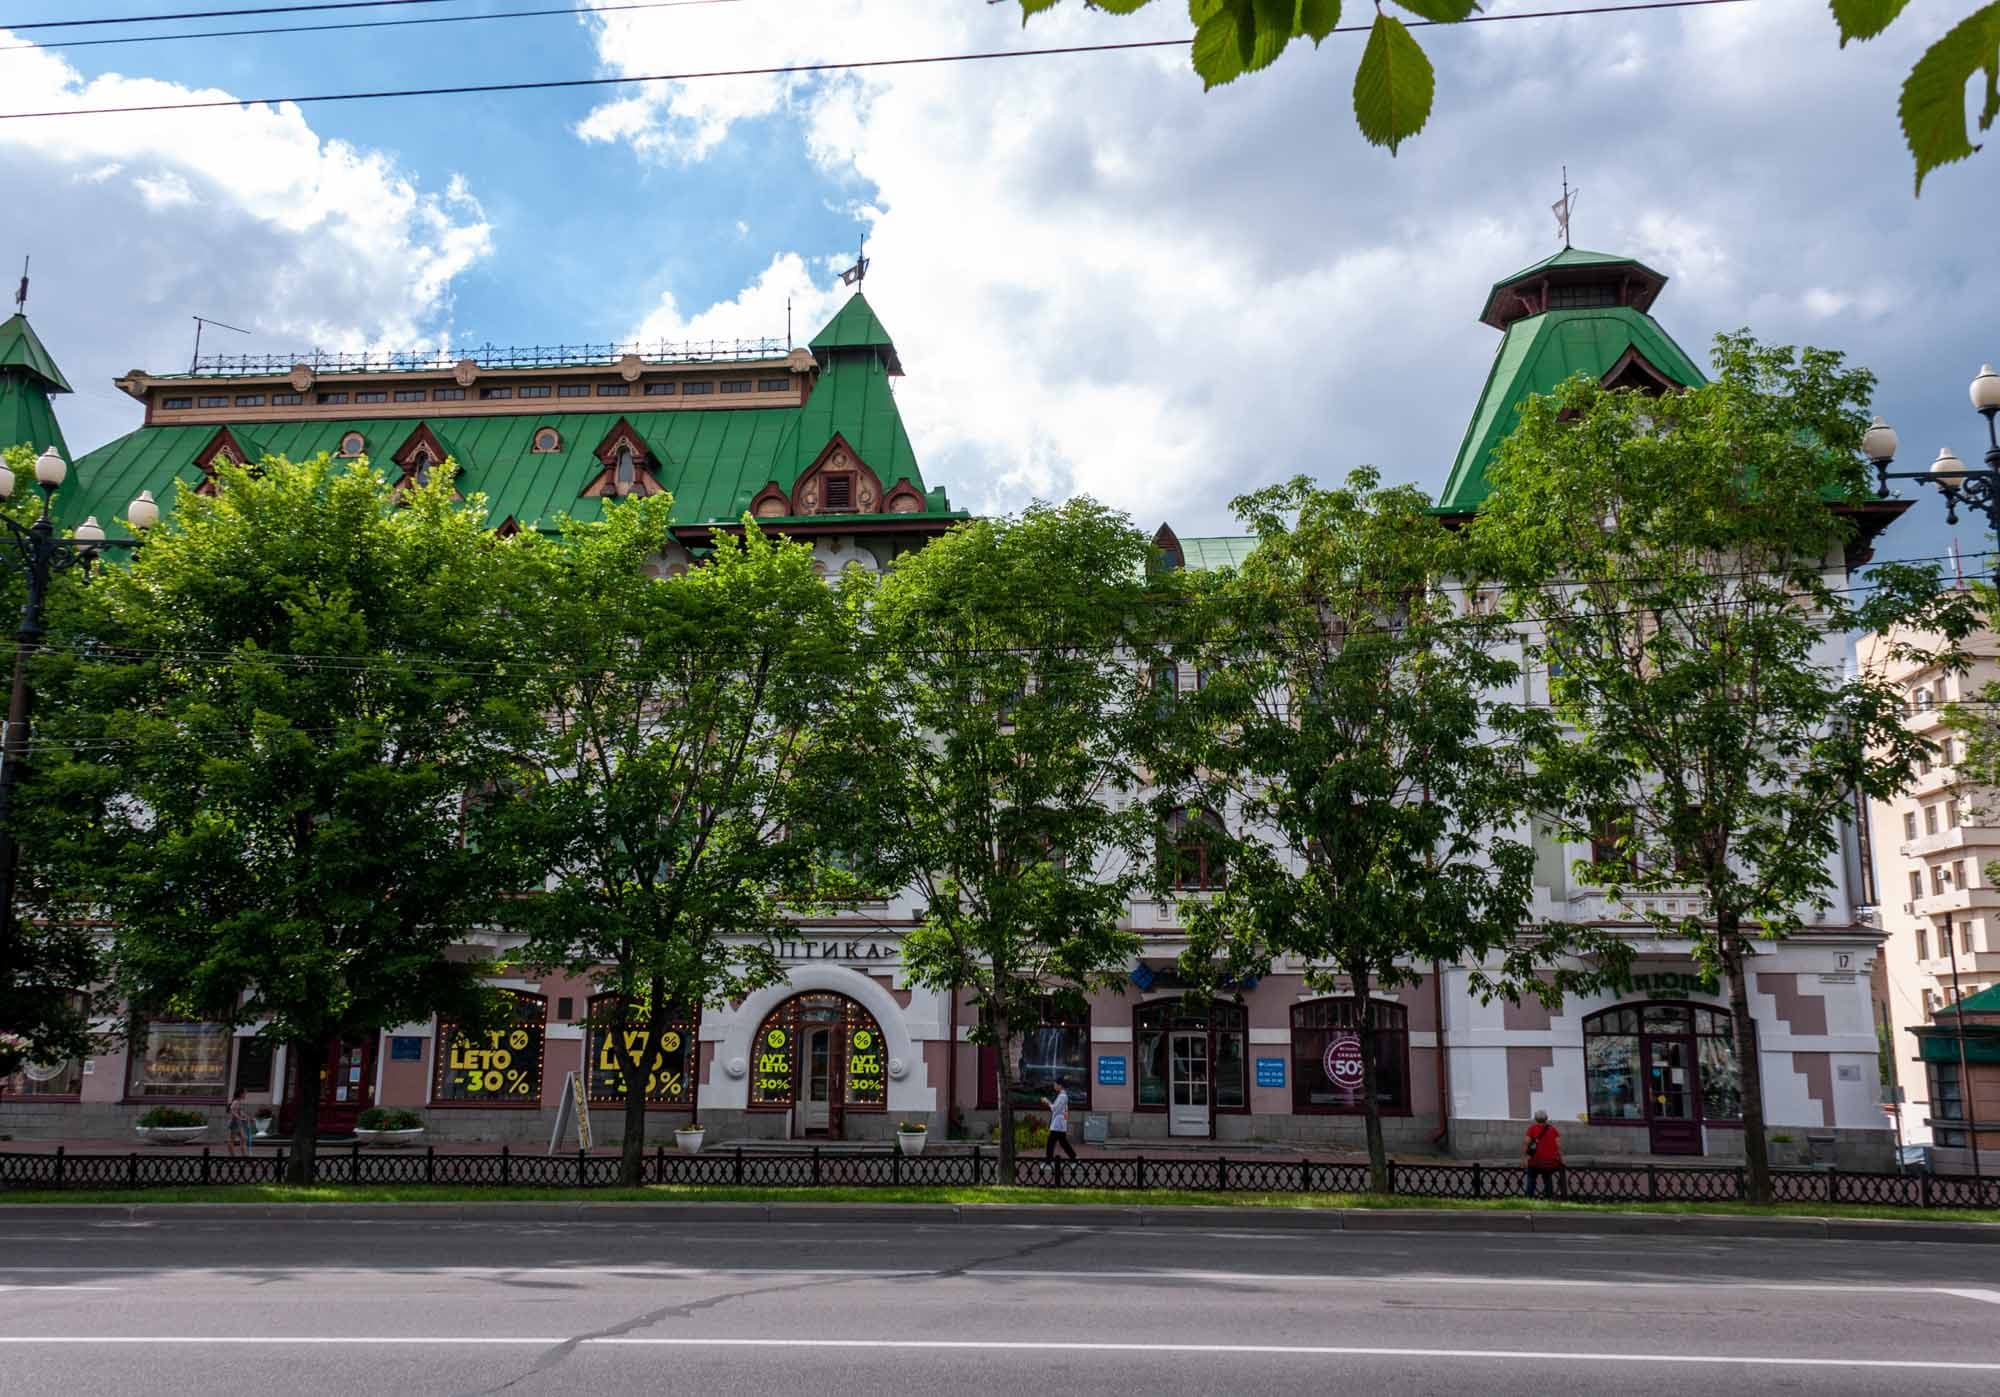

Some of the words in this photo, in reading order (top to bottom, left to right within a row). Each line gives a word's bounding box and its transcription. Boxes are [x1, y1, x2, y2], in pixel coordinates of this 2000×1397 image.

[760, 941, 880, 959] ОПТИКА
[1839, 954, 1849, 969] 17
[453, 1070, 530, 1095] -30%
[755, 1078, 790, 1089] -30%
[847, 1079, 881, 1091] -30%
